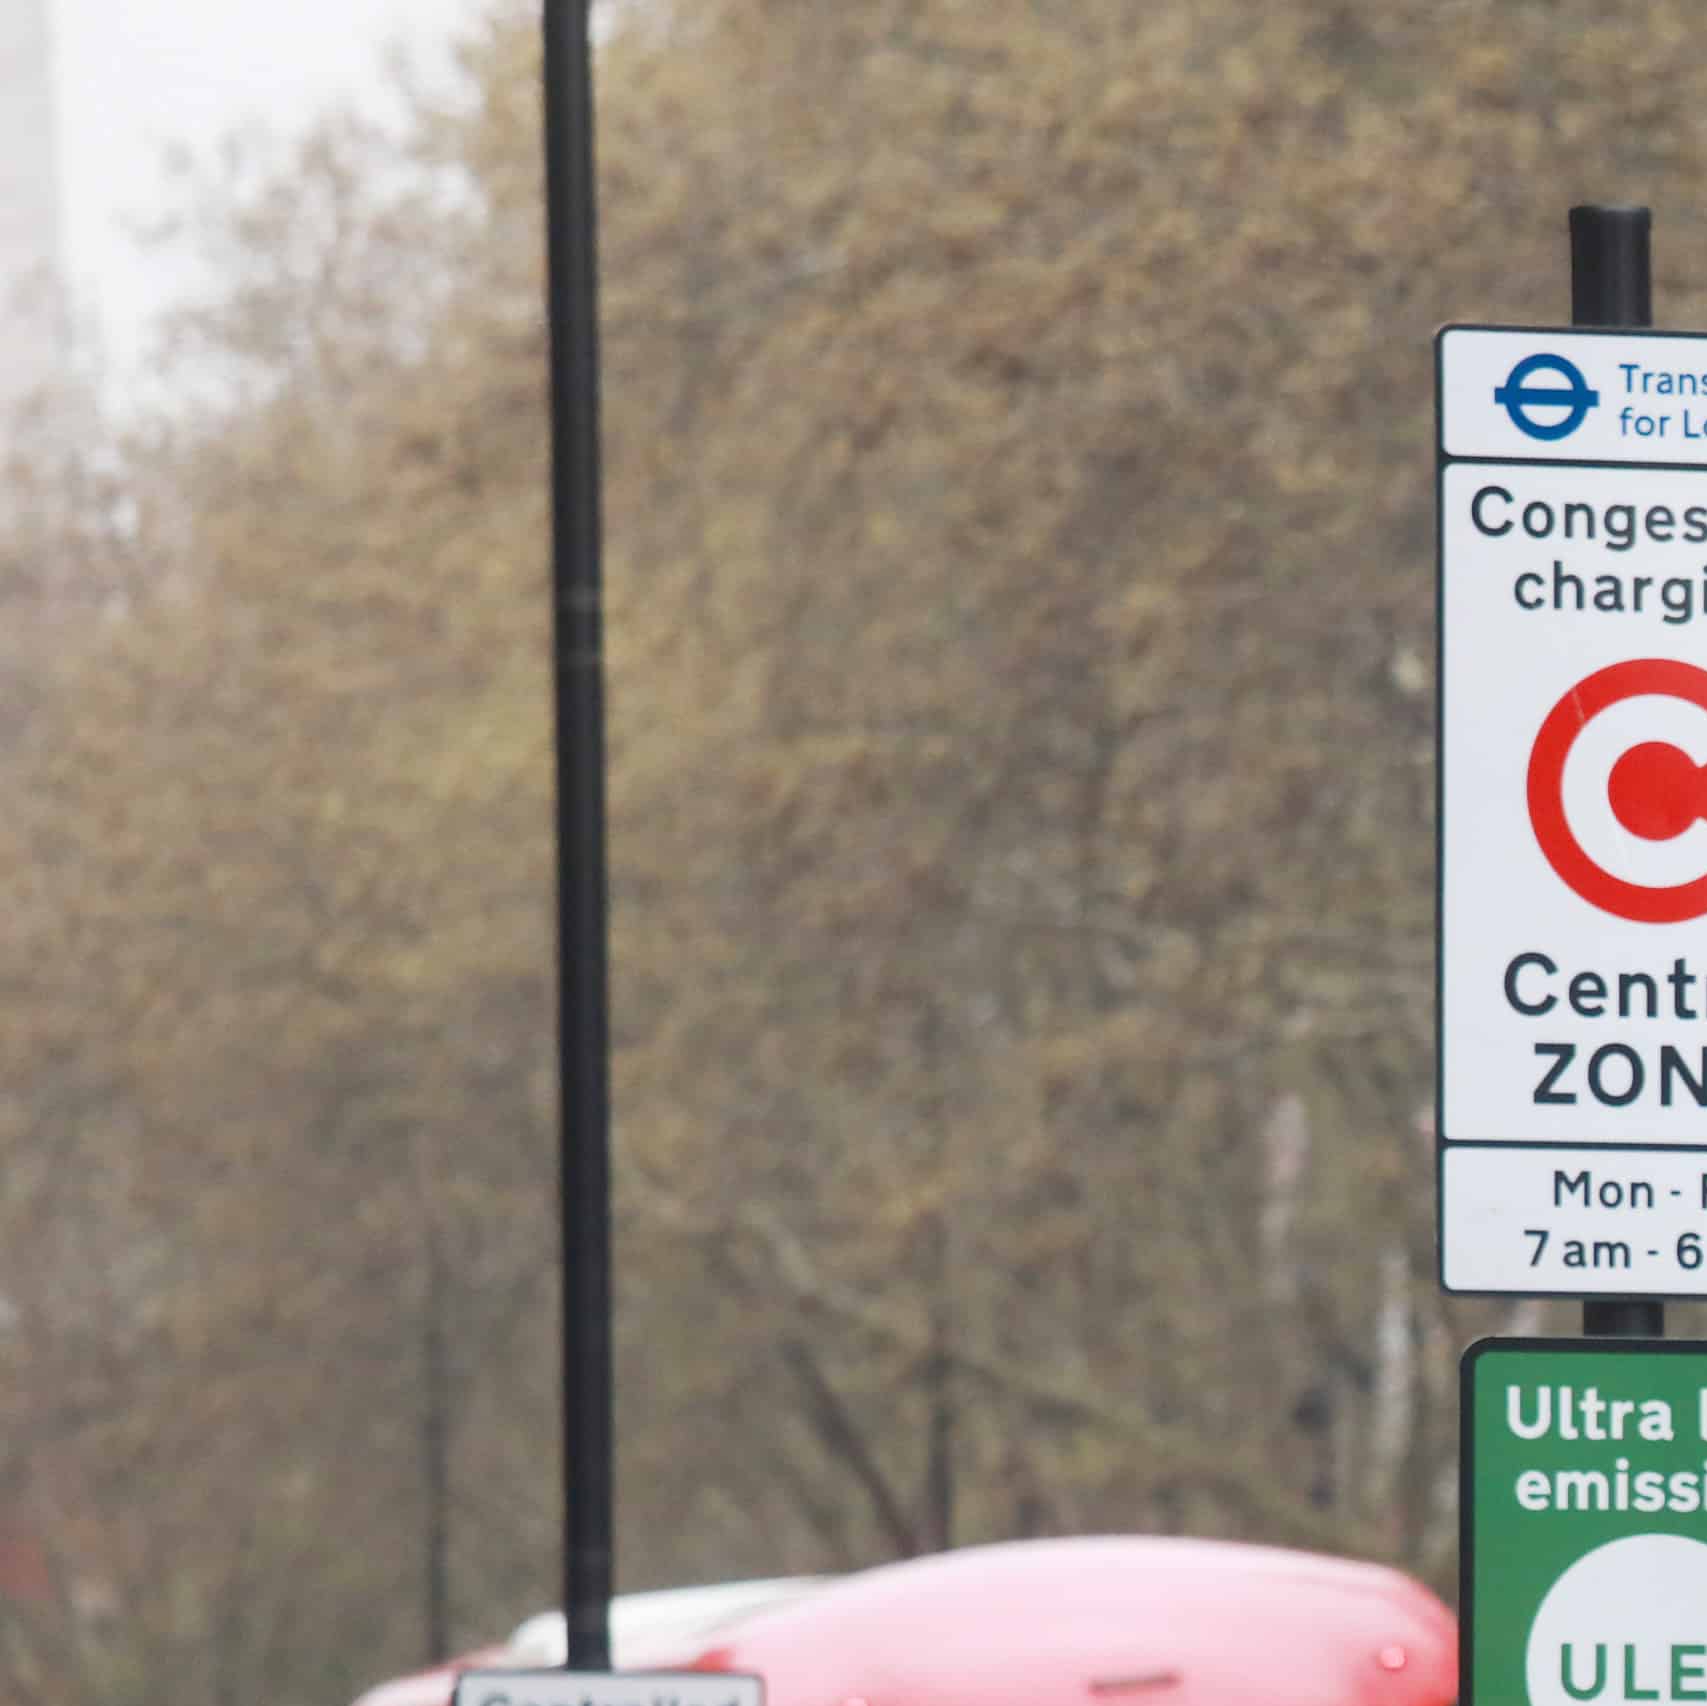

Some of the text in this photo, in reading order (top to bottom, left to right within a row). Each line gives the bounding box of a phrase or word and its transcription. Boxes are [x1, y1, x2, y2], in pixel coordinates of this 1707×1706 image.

[1619, 408, 1671, 438] for
[1553, 1170, 1655, 1209] Mon
[1523, 1229, 1550, 1268] 7
[1562, 1239, 1632, 1269] am
[1675, 1232, 1704, 1271] 6
[1506, 1384, 1674, 1441] Ultra
